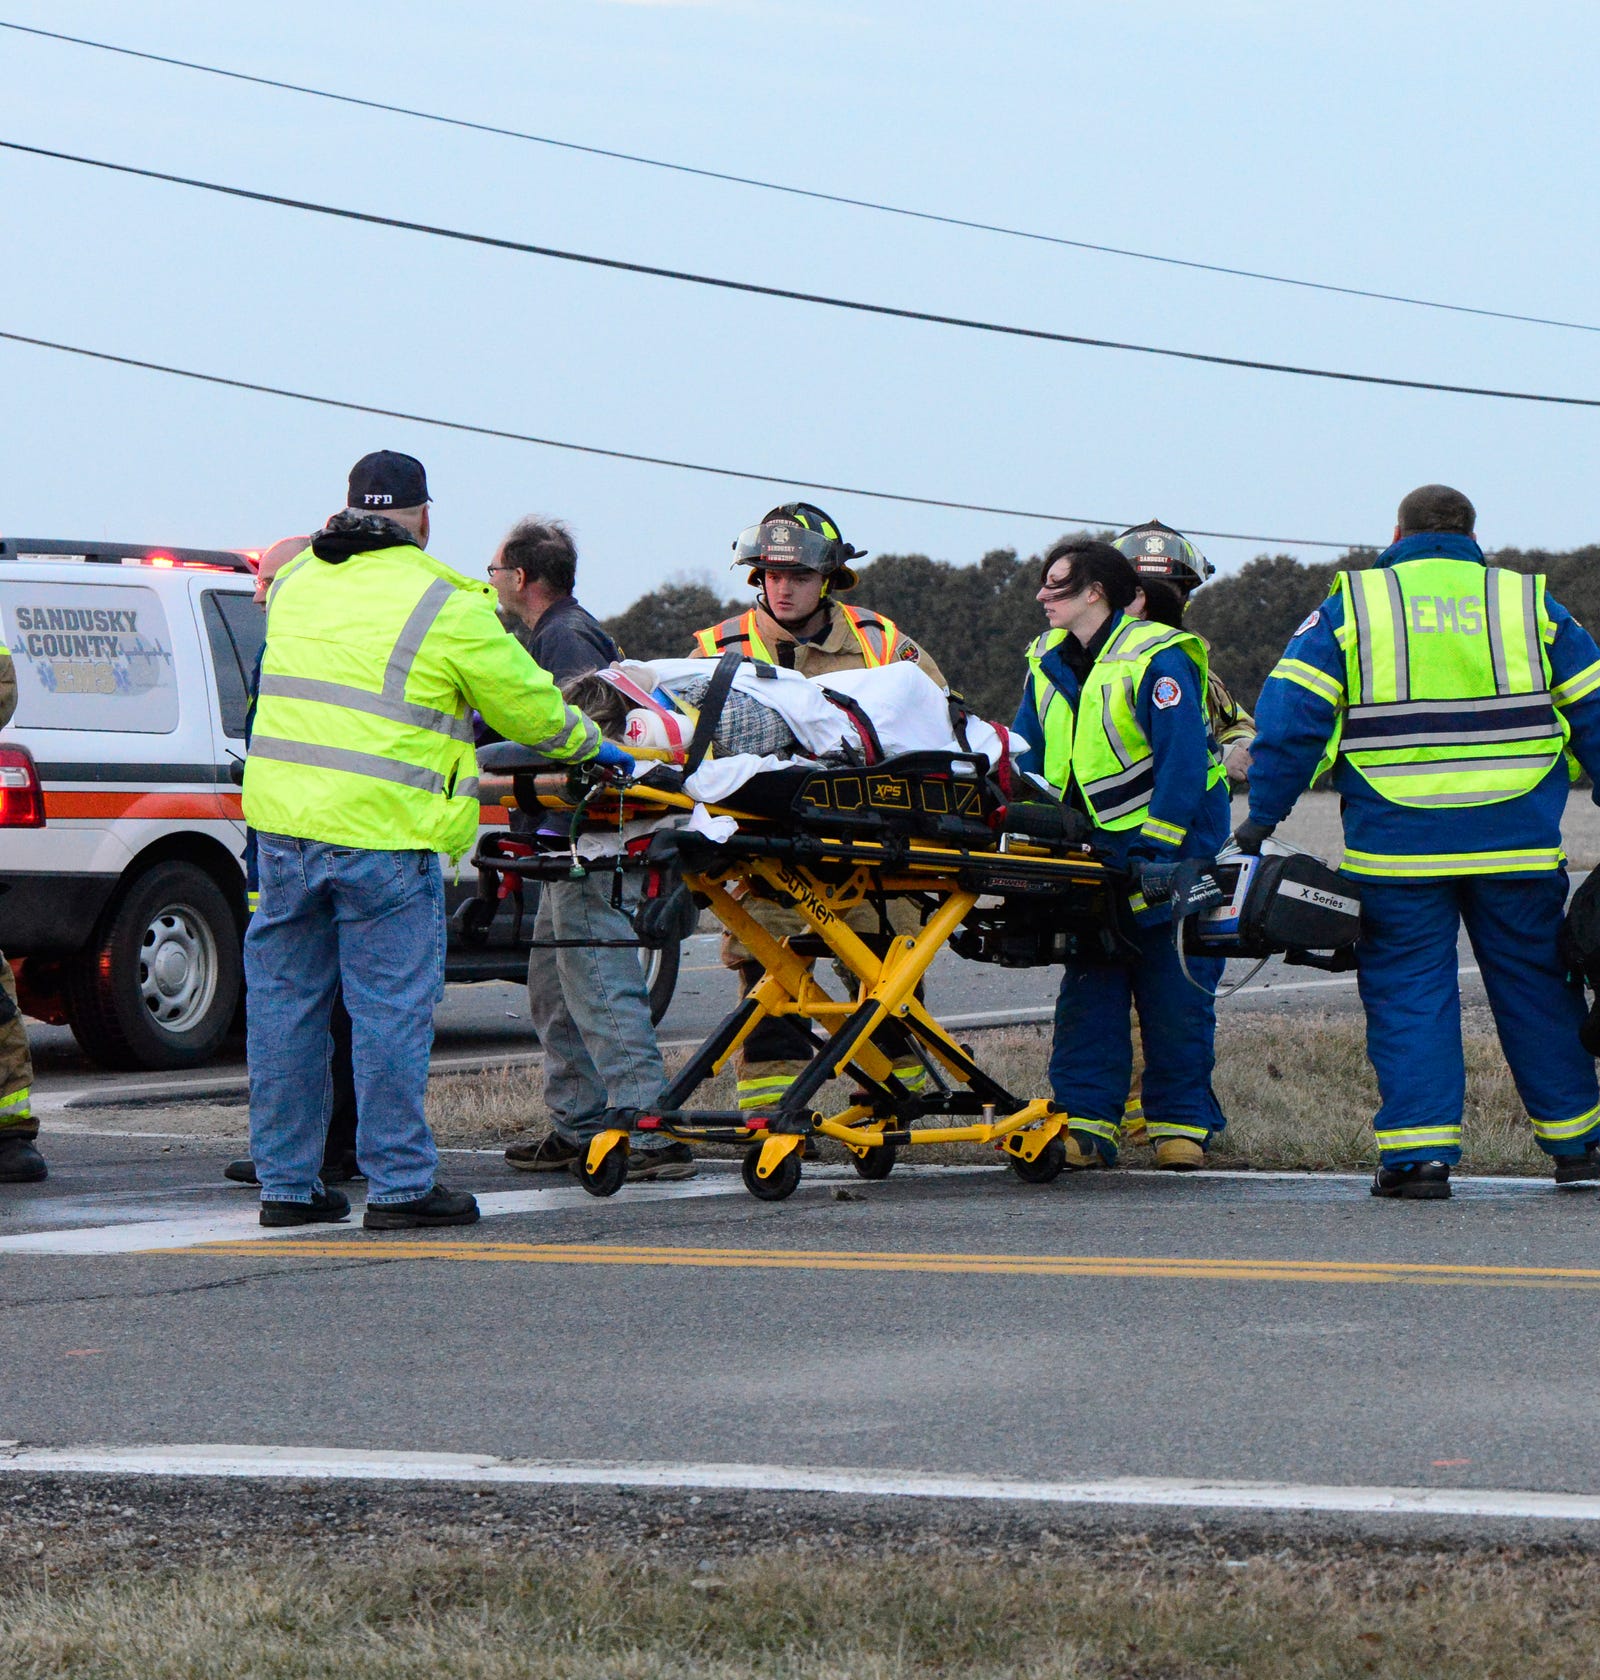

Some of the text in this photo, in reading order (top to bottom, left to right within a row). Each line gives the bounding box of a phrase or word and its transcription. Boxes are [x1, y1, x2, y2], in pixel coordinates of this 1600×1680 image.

[363, 494, 393, 505] FFD
[15, 606, 138, 633] SANDUSKY
[1409, 595, 1483, 636] EMS
[26, 633, 119, 658] COUNTY
[51, 660, 116, 694] EMS
[875, 784, 902, 800] XPS
[1300, 888, 1343, 909] X Series
